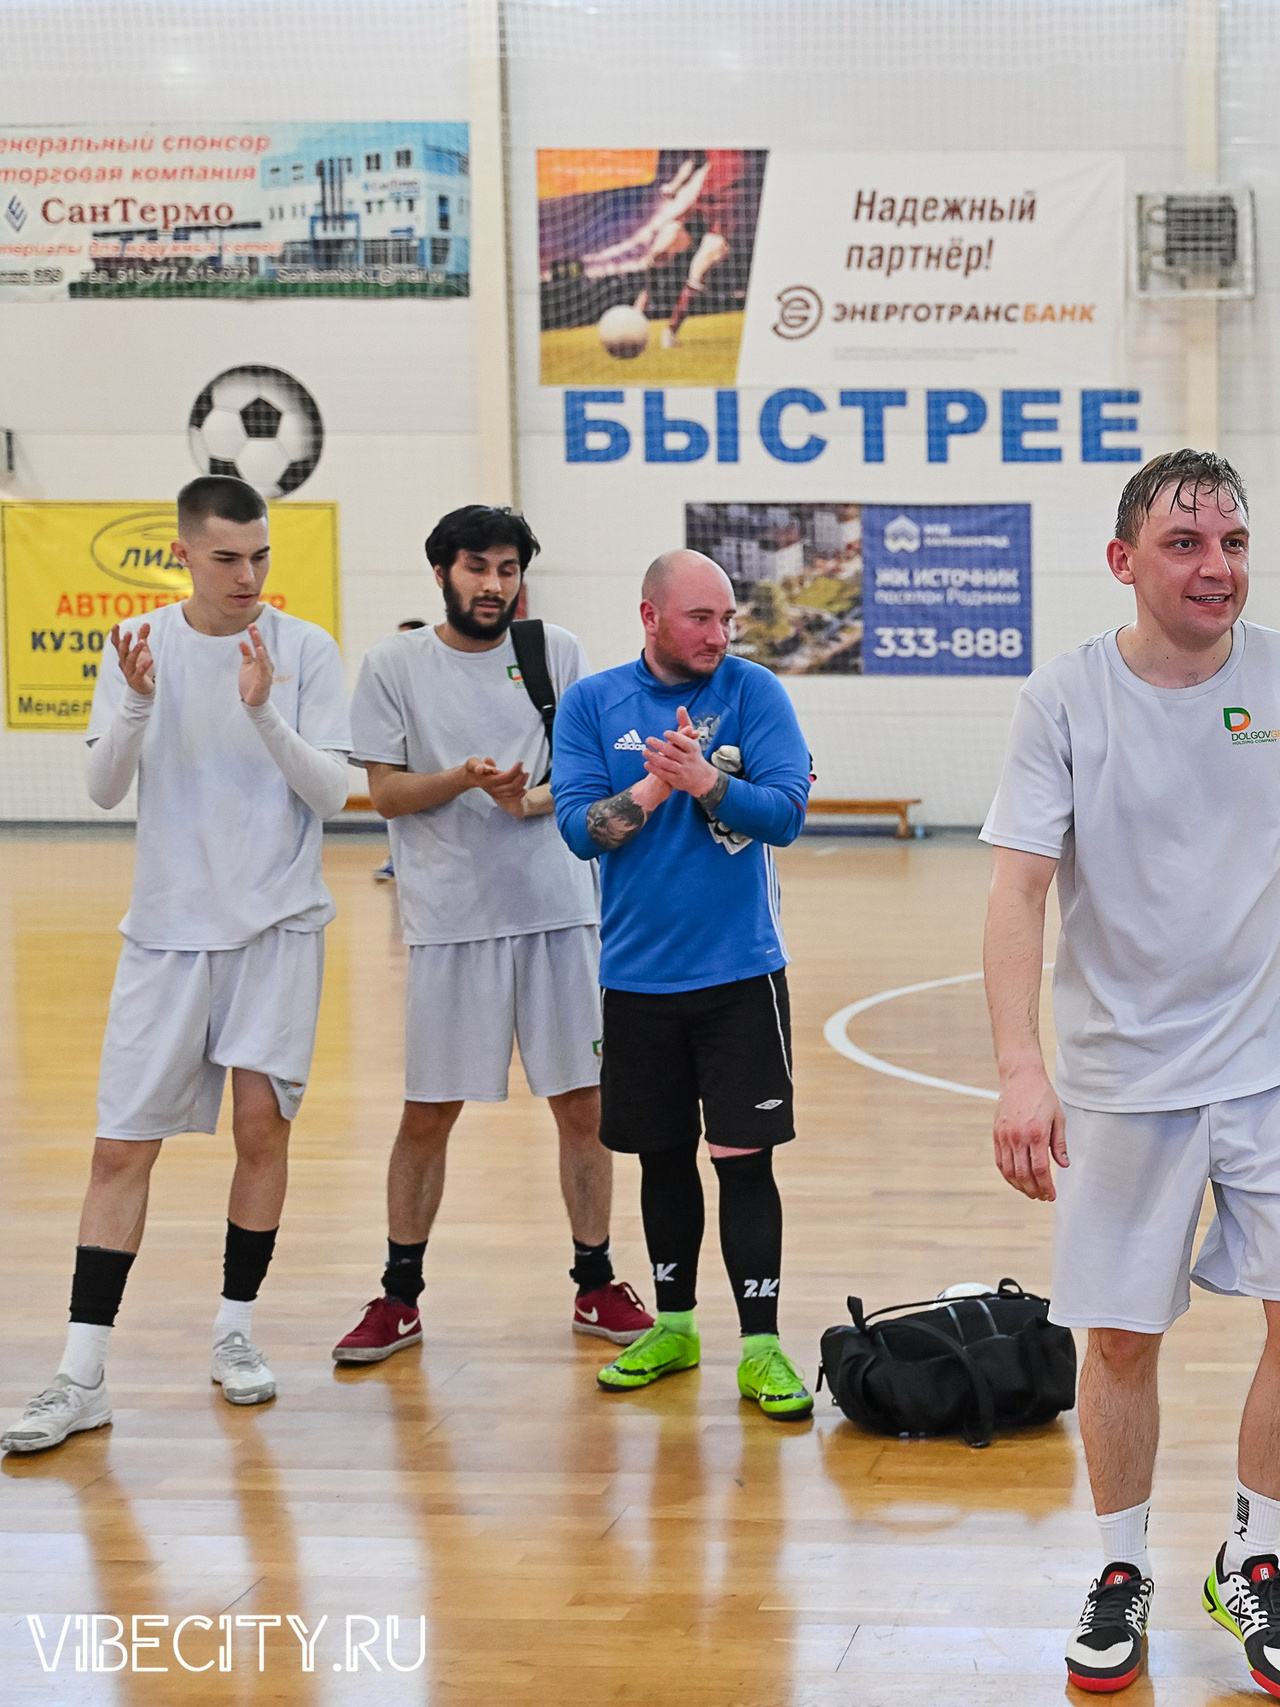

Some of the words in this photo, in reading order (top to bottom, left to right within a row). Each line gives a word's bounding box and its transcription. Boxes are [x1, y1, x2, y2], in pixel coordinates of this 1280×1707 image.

[0, 132, 154, 159] енеральный
[163, 135, 271, 154] спонсор
[0, 166, 122, 187] торговая
[131, 166, 256, 181] компания
[41, 197, 234, 229] СанТермо
[852, 189, 1037, 228] Надежный
[846, 238, 994, 278] партнёр!
[832, 303, 1096, 323] ЭНЕРГОТРАНСБАНК
[564, 388, 1143, 464] БЫСТРЕЕ
[120, 548, 184, 569] ЛИД
[31, 631, 104, 652] КУЗО
[874, 627, 1023, 659] 333-888
